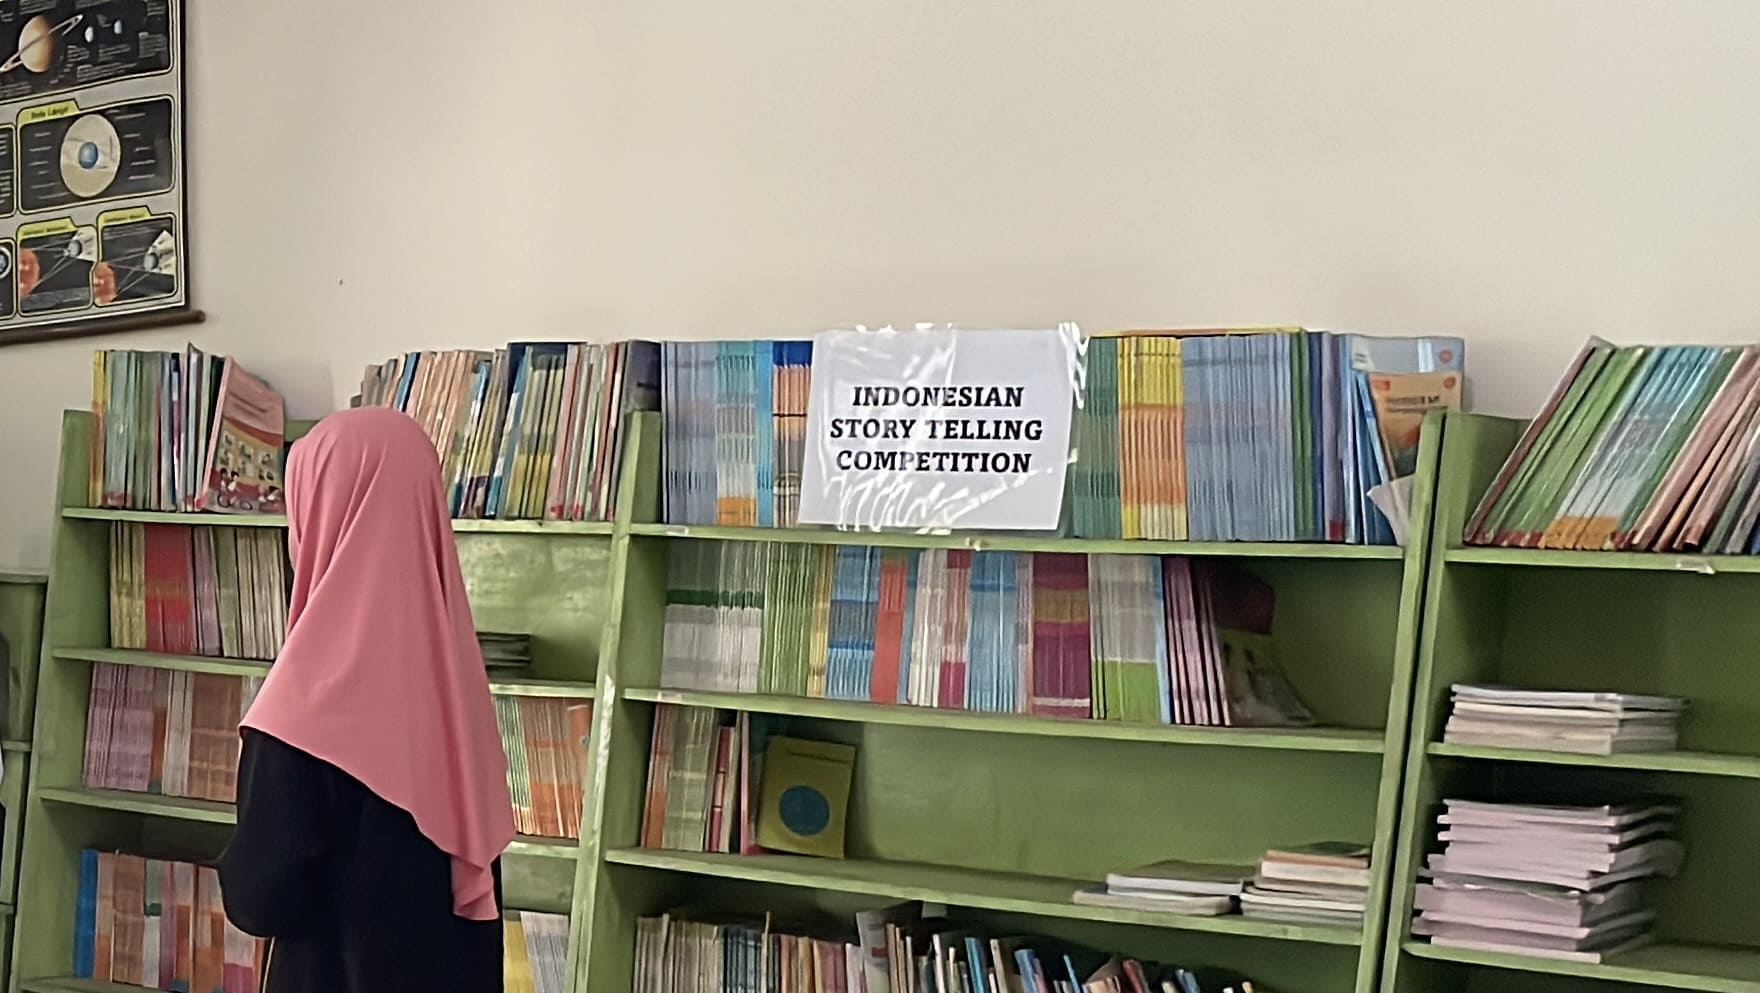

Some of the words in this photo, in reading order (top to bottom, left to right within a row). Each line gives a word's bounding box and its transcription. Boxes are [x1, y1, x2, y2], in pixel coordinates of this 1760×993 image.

[852, 386, 1024, 407] INDONESIAN
[830, 418, 916, 438] STORY
[925, 419, 1043, 441] TELLING
[836, 450, 1032, 473] COMPETITION
